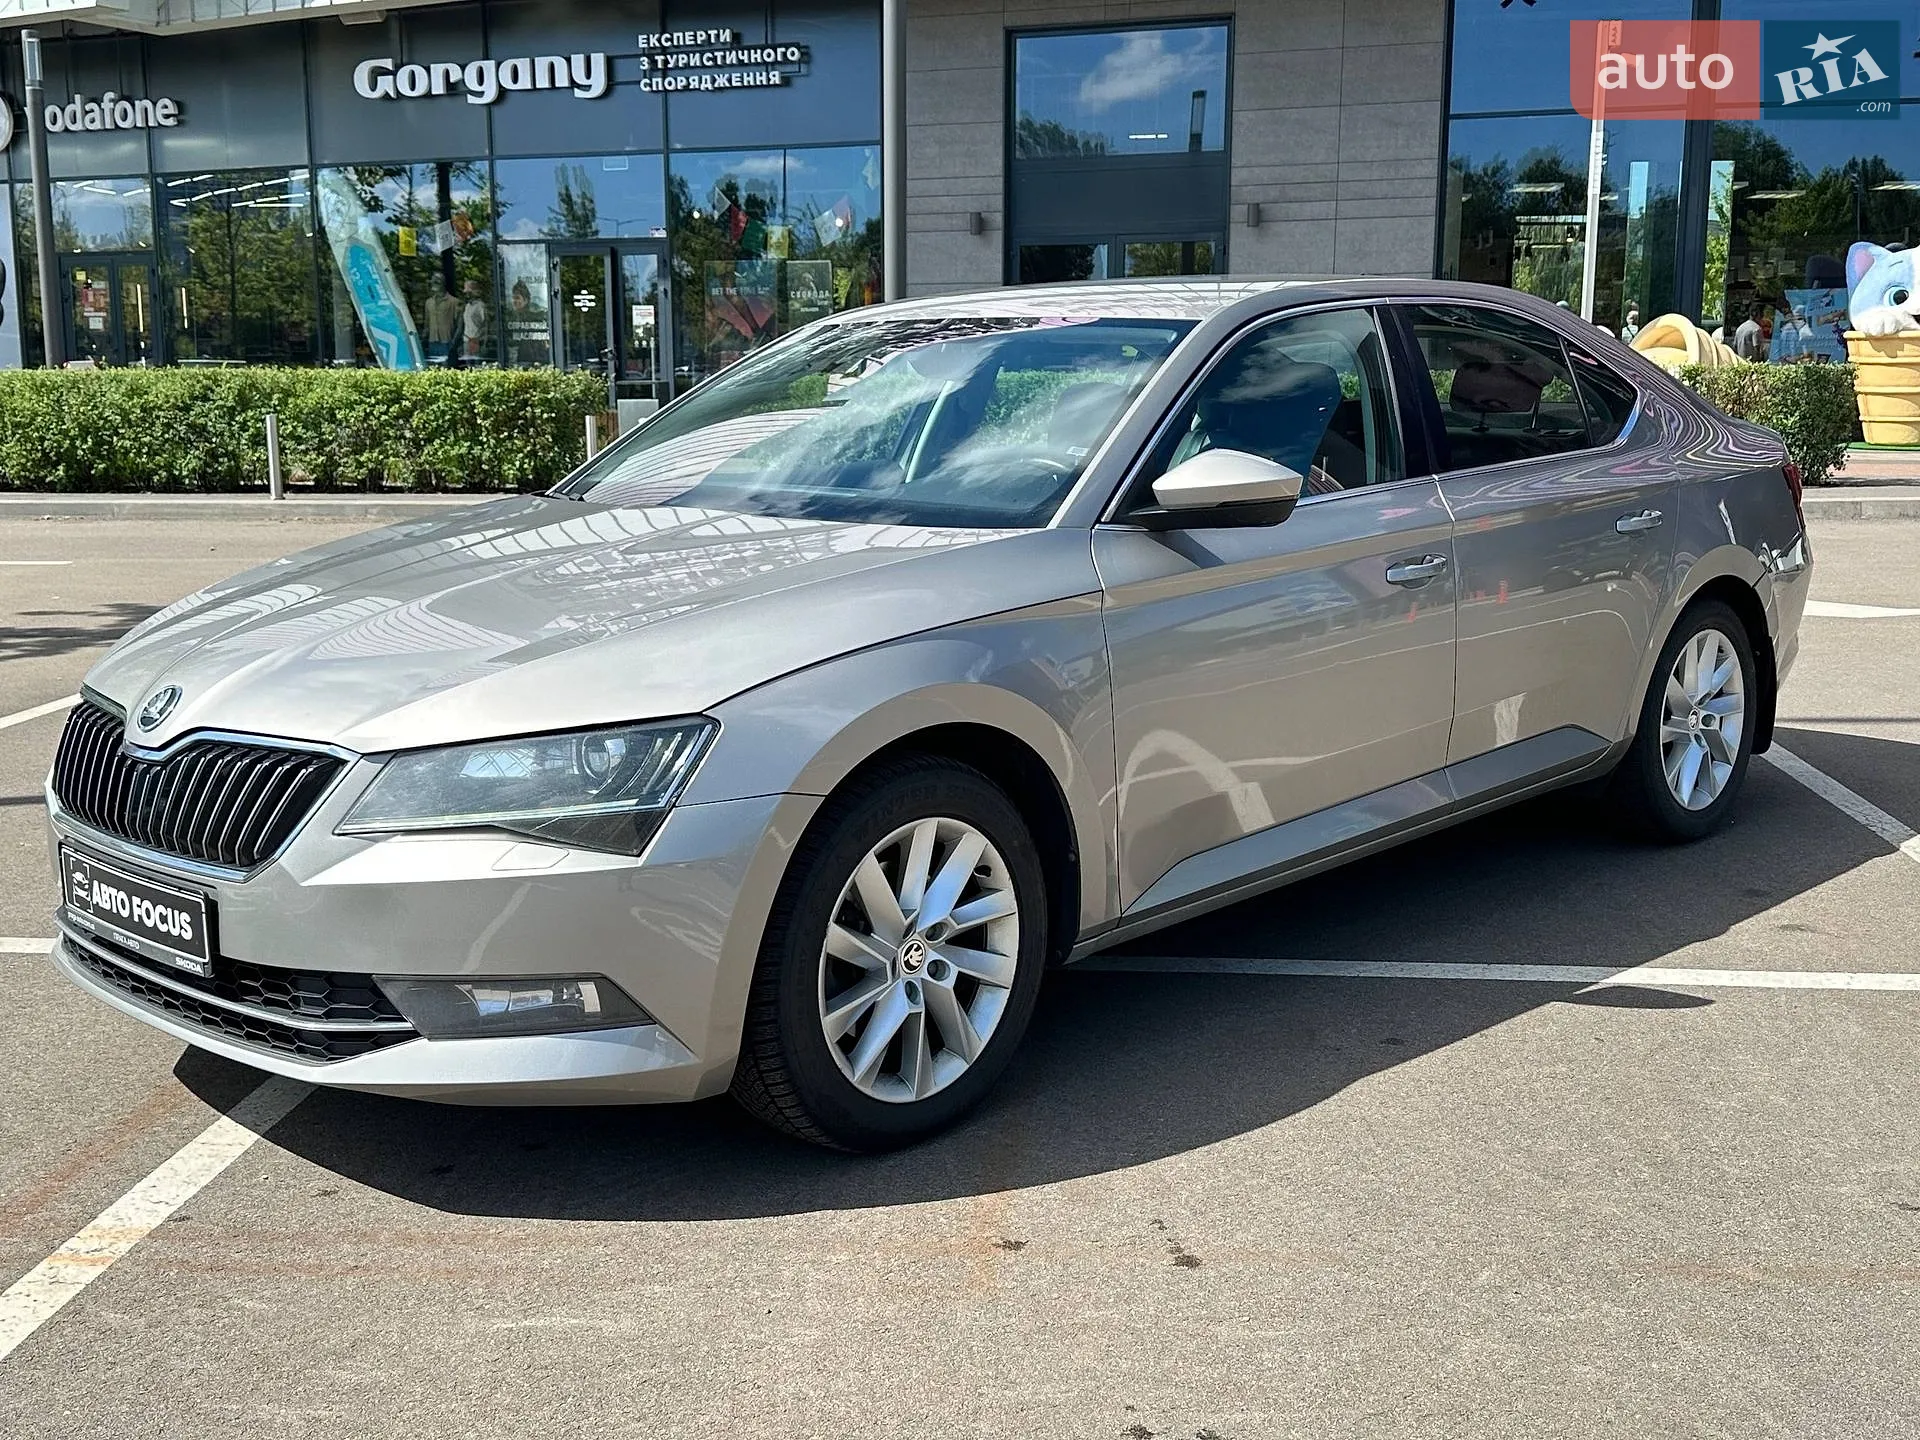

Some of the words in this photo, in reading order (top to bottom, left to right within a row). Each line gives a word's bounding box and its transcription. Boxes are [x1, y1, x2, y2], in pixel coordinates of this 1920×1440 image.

[638, 28, 732, 49] ЕКСПЕРТИ
[654, 46, 801, 70] ТУРИСТИЧНОГО
[353, 52, 608, 104] Gorgany
[639, 70, 782, 92] СПОРЯДЖЕННЯ
[24, 91, 179, 133] odafone
[92, 880, 130, 918] АВТО
[131, 896, 193, 941] FOCUS
